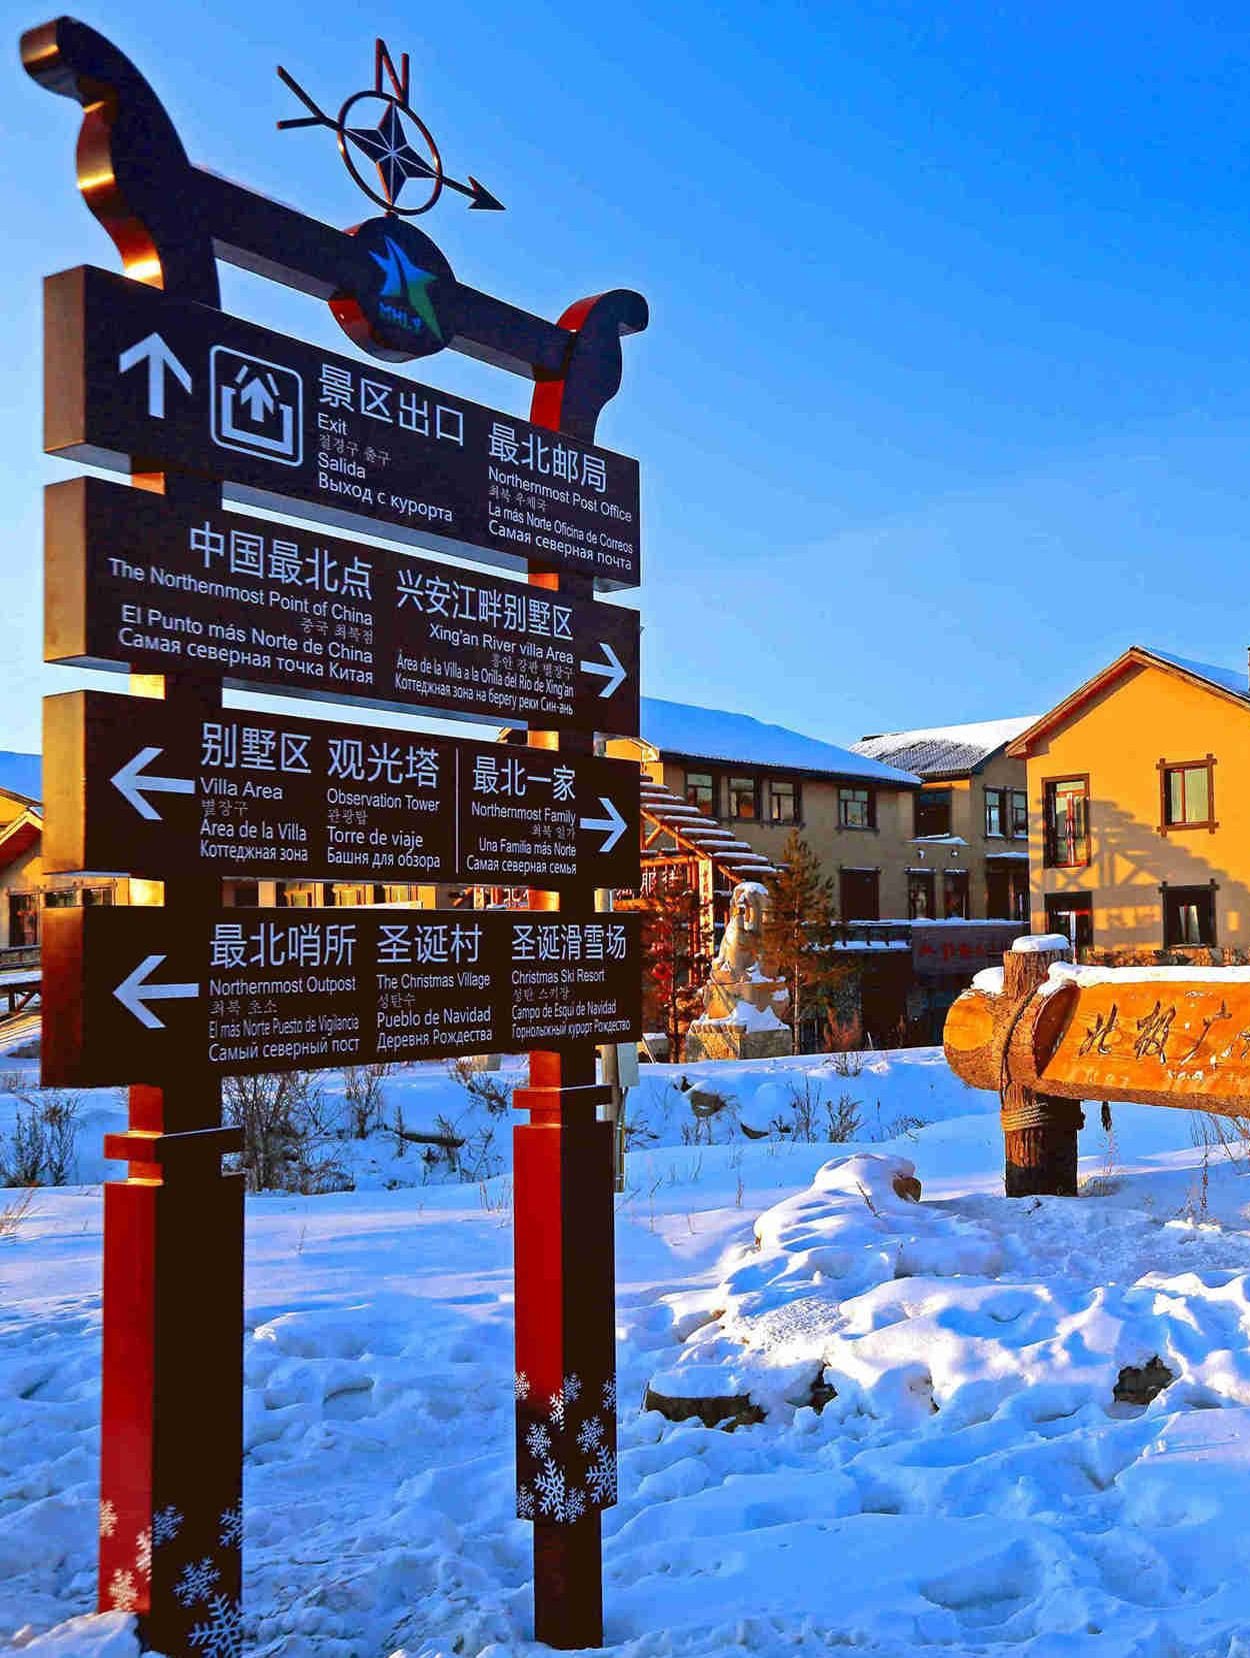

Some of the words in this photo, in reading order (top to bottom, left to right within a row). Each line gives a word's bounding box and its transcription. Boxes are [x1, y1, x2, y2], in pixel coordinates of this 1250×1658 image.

[318, 363, 464, 446] 景区出口
[318, 412, 348, 436] Exit
[318, 452, 366, 479] Salida
[488, 421, 608, 493] 最北邮局
[318, 472, 374, 505] Выход
[377, 492, 386, 504] с
[391, 493, 453, 522] курорта
[488, 465, 570, 505] Northernmost
[573, 493, 598, 513] Post
[600, 501, 632, 522] Office
[488, 501, 501, 516] La
[503, 507, 524, 522] más
[527, 511, 552, 531] Norte
[554, 519, 584, 541] Oficina
[586, 529, 598, 544] de
[599, 533, 633, 554] Correos
[488, 519, 532, 545] Самая
[535, 535, 594, 560] северная
[597, 552, 632, 570] почта
[189, 521, 373, 600] 中国最北点
[108, 557, 145, 582] The
[150, 567, 264, 606] Northernmost
[269, 591, 309, 615] Point
[313, 600, 328, 617] of
[331, 603, 373, 626] China
[397, 568, 573, 641] 兴安江畔别墅区
[121, 604, 142, 625] El
[148, 609, 203, 635] Punto
[208, 623, 246, 643] más
[251, 629, 298, 652] Norte
[303, 637, 323, 656] de
[328, 641, 373, 664] China
[429, 623, 479, 646] Xing'an
[482, 633, 517, 653] River
[519, 644, 544, 659] villa
[545, 646, 574, 664] Area
[118, 627, 181, 655] Самая
[187, 641, 271, 669] северная
[276, 657, 324, 677] точка
[329, 662, 374, 685] Китая
[420, 656, 432, 674] de
[433, 658, 442, 675] la
[443, 660, 462, 679] Villa
[463, 668, 470, 680] a
[471, 665, 480, 682] la
[480, 668, 503, 686] Orilla
[504, 673, 517, 688] del
[534, 676, 545, 693] de
[452, 685, 474, 700] зона
[476, 689, 487, 702] на
[488, 687, 517, 710] берегу
[519, 696, 539, 711] реки
[201, 722, 312, 774] 别墅区
[328, 739, 440, 789] 观光塔
[200, 777, 238, 796] Villa
[242, 780, 283, 800] Area
[473, 755, 576, 801] 最北一家
[327, 788, 402, 810] Observation
[404, 794, 440, 812] Tower
[471, 801, 542, 821] Northernmost
[544, 807, 576, 827] Family
[239, 819, 257, 838] de
[262, 821, 273, 840] la
[278, 822, 308, 841] Villa
[327, 826, 365, 844] Torre
[369, 828, 388, 846] de
[391, 830, 423, 850] viaje
[200, 839, 277, 862] Коттеджная
[280, 848, 308, 862] зона
[327, 847, 369, 864] Башня
[372, 852, 394, 868] для
[398, 848, 440, 872] обзора
[479, 837, 498, 852] Una
[500, 838, 532, 854] Familia
[534, 841, 552, 855] más
[554, 842, 576, 857] Norte
[466, 854, 499, 871] Самая
[501, 859, 547, 876] северная
[549, 862, 576, 875] семья
[210, 922, 357, 968] 最北哨所
[377, 923, 482, 964] 圣诞村
[511, 924, 626, 961] 圣诞滑雪场
[209, 977, 303, 996] Northernmost
[306, 976, 356, 995] Outpost
[376, 974, 398, 989] The
[400, 973, 454, 988] Christmas
[457, 972, 491, 989] Village
[511, 969, 559, 984] Christmas
[560, 968, 575, 982] Ski
[576, 968, 605, 982] Resort
[377, 1009, 421, 1028] Pueblo
[424, 1008, 440, 1025] de
[443, 1005, 491, 1024] Navidad
[511, 1005, 540, 1023] Campo
[542, 1002, 552, 1017] de
[576, 1000, 586, 1016] de
[587, 998, 617, 1015] Navidad
[208, 1021, 217, 1039] El
[243, 1019, 270, 1037] Norte
[272, 1017, 303, 1035] Puesto
[305, 1016, 317, 1032] de
[377, 1032, 430, 1053] Деревня
[433, 1028, 492, 1046] Рождества
[568, 1022, 593, 1040] курорт
[208, 1041, 258, 1062] Самый
[262, 1037, 328, 1060] северный
[332, 1037, 361, 1053] пост
